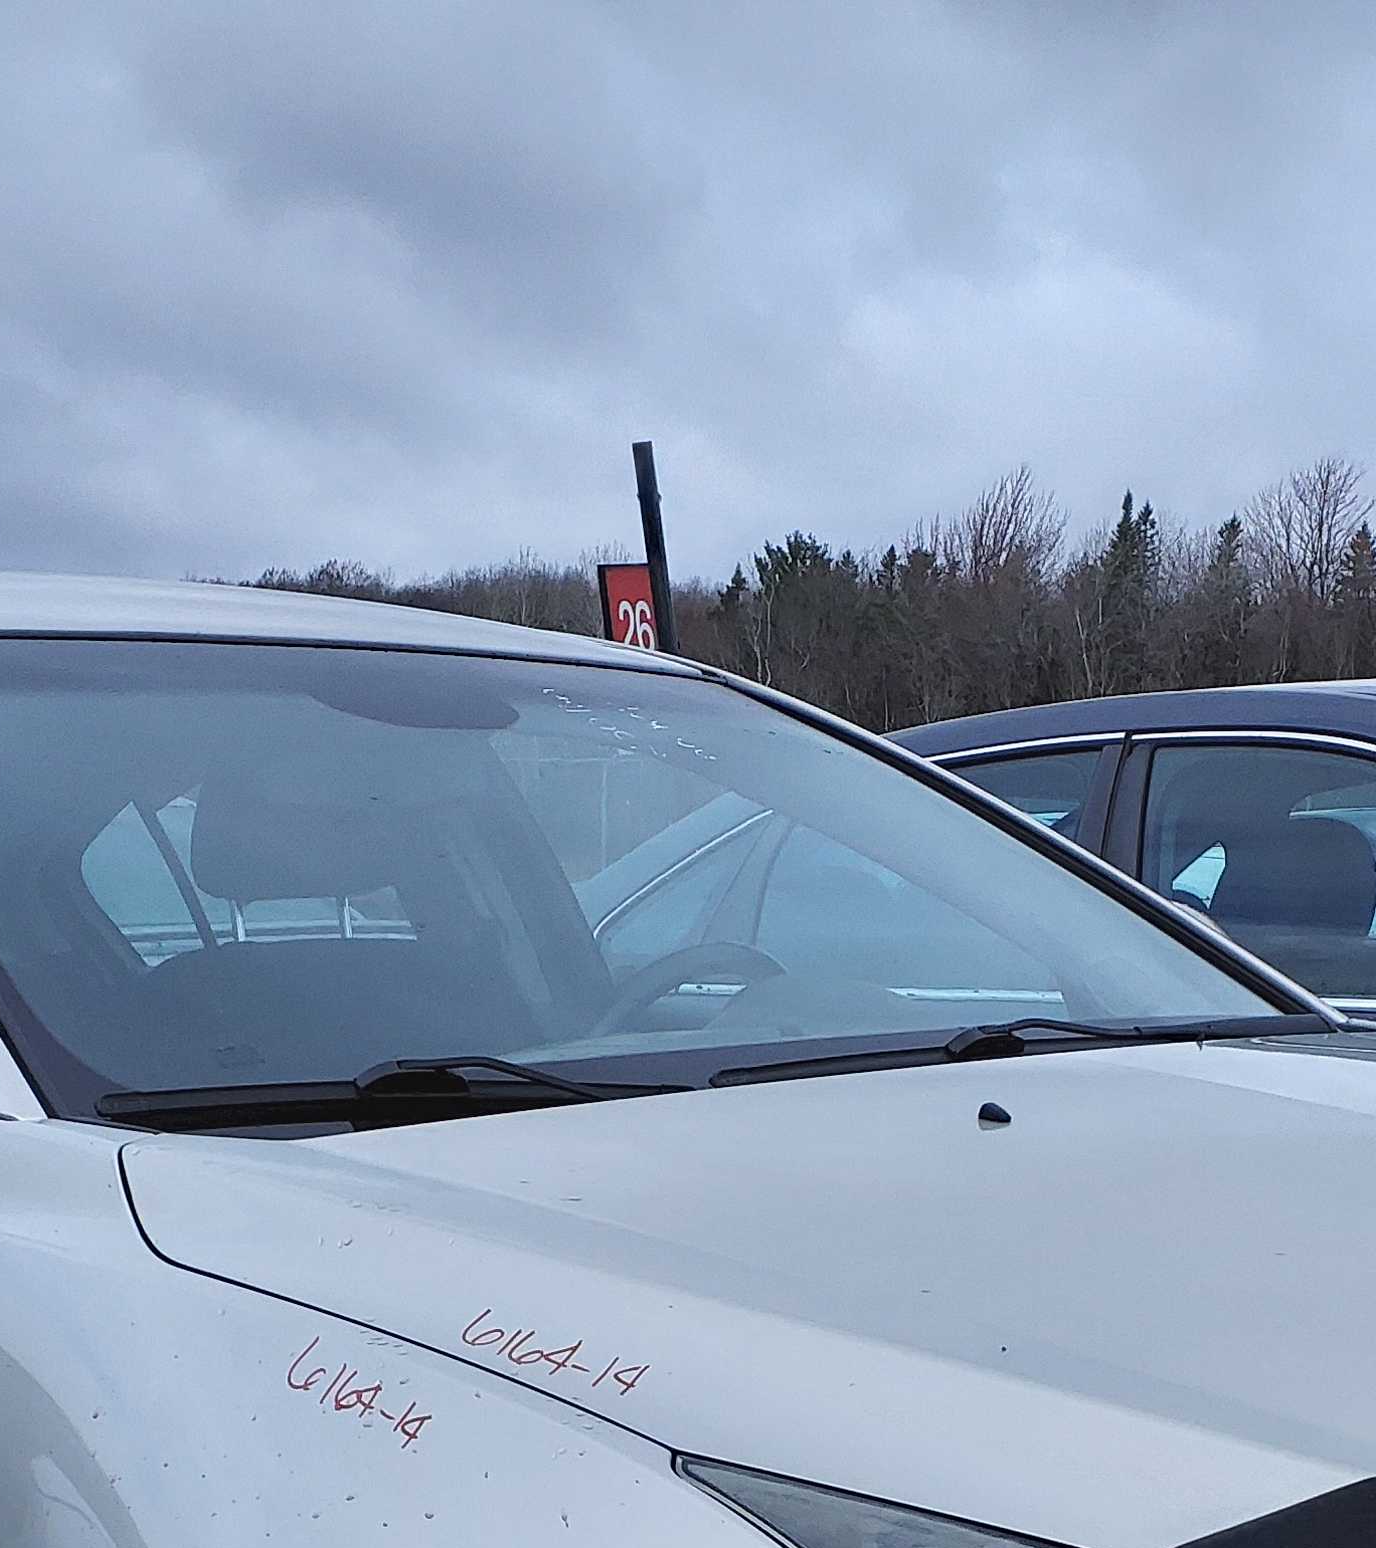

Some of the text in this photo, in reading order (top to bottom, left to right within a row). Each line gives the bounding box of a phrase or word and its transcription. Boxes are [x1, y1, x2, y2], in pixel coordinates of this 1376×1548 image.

[618, 600, 656, 650] 26
[286, 1336, 433, 1449] 6164-14
[461, 1308, 651, 1396] 6164-14
